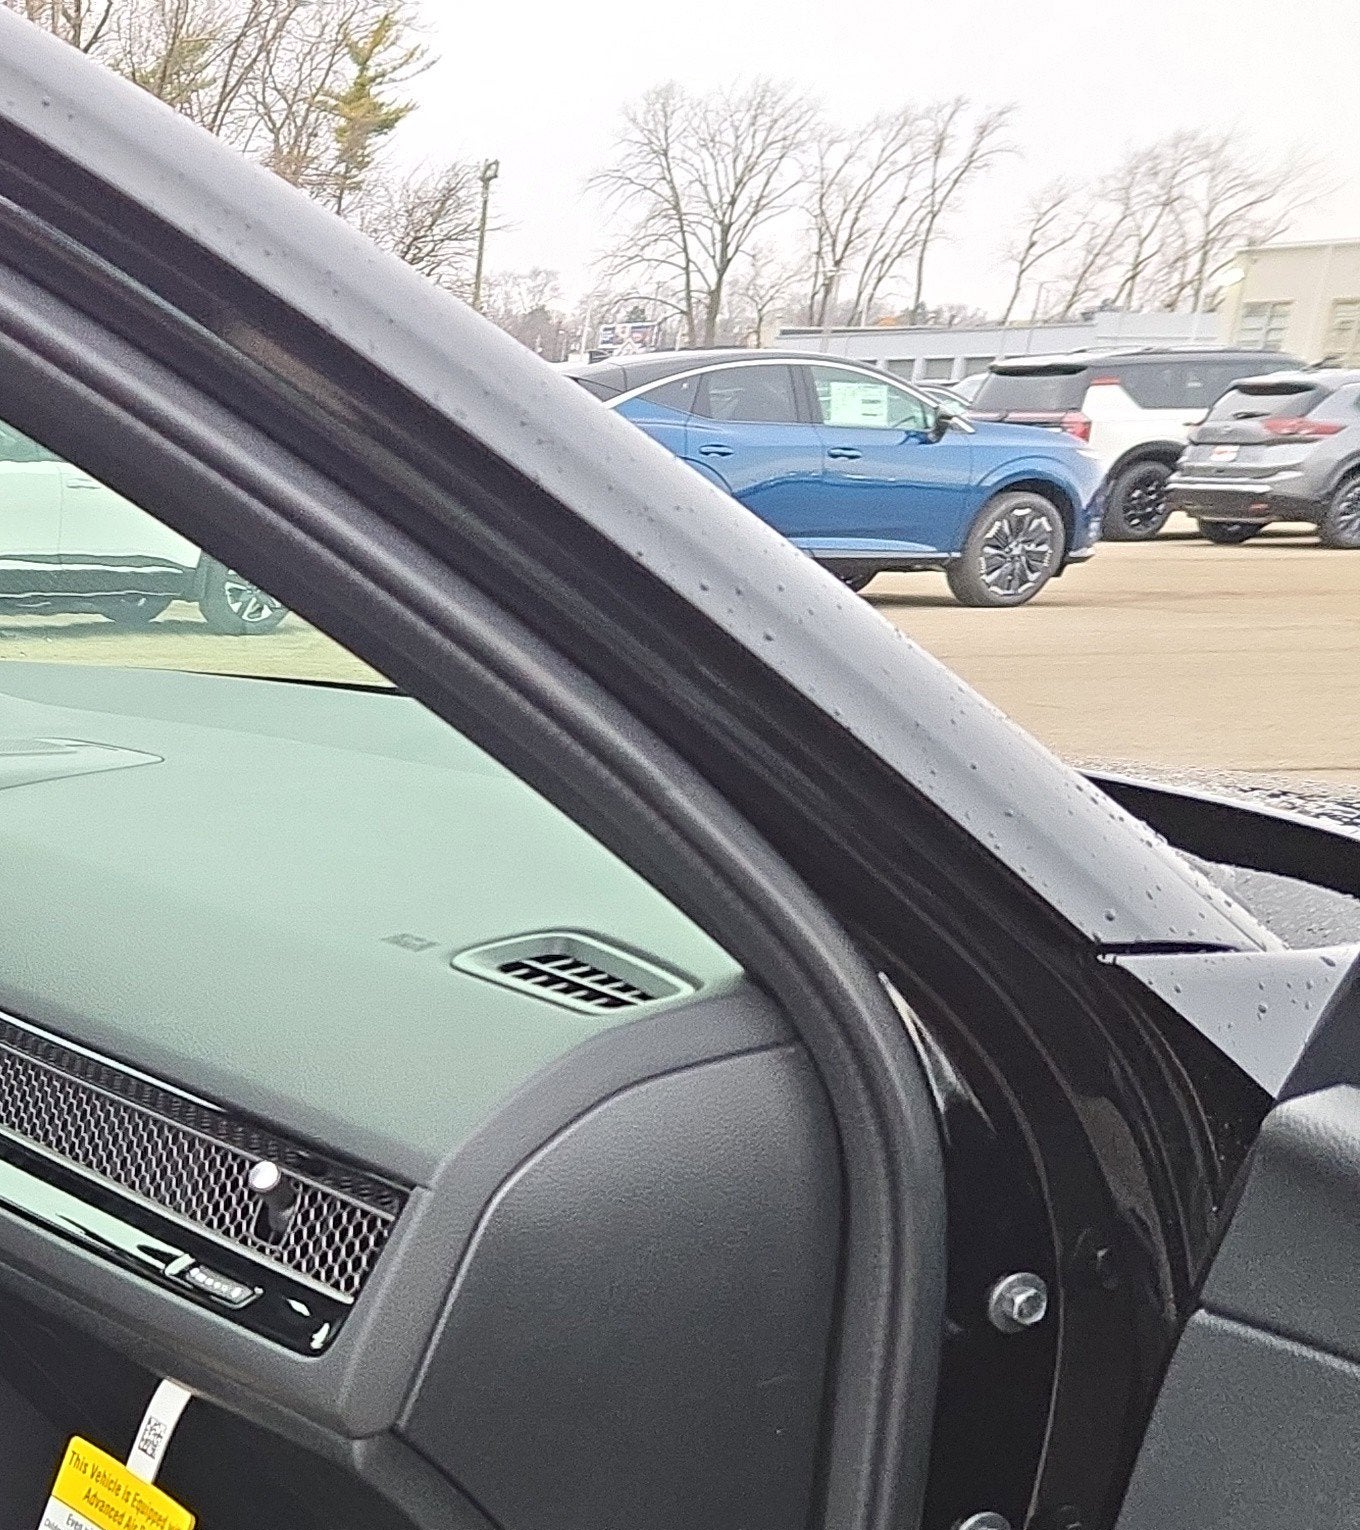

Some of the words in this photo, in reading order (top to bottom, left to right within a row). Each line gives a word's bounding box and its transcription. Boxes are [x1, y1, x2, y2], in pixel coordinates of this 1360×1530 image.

[68, 1450, 88, 1474] This
[89, 1463, 121, 1496] Vehicle
[121, 1485, 131, 1503] is
[130, 1492, 167, 1530] Equipped
[82, 1487, 125, 1525] Advanced
